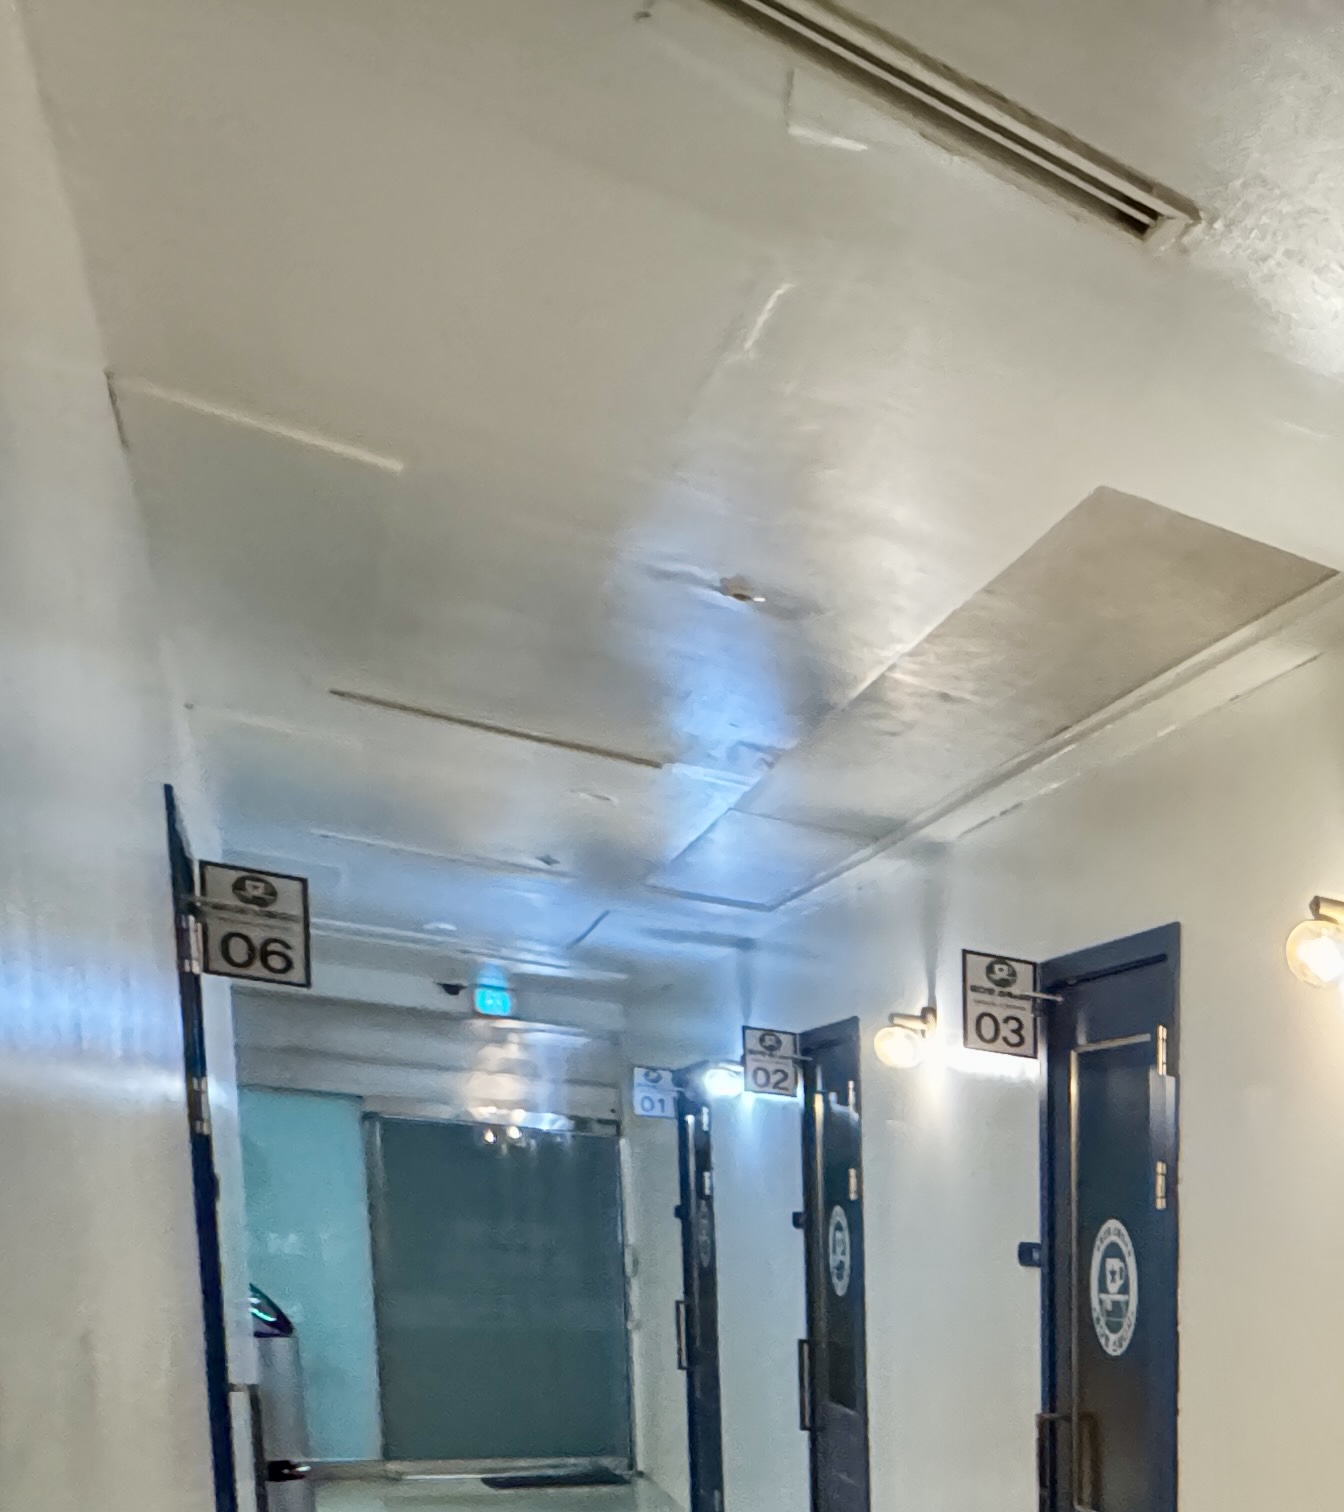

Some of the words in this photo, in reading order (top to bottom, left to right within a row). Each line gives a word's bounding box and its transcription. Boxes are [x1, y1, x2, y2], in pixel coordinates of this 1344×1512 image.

[220, 931, 294, 975] 06
[975, 1011, 1025, 1048] 03
[752, 1066, 791, 1091] 02
[640, 1095, 666, 1114] 01
